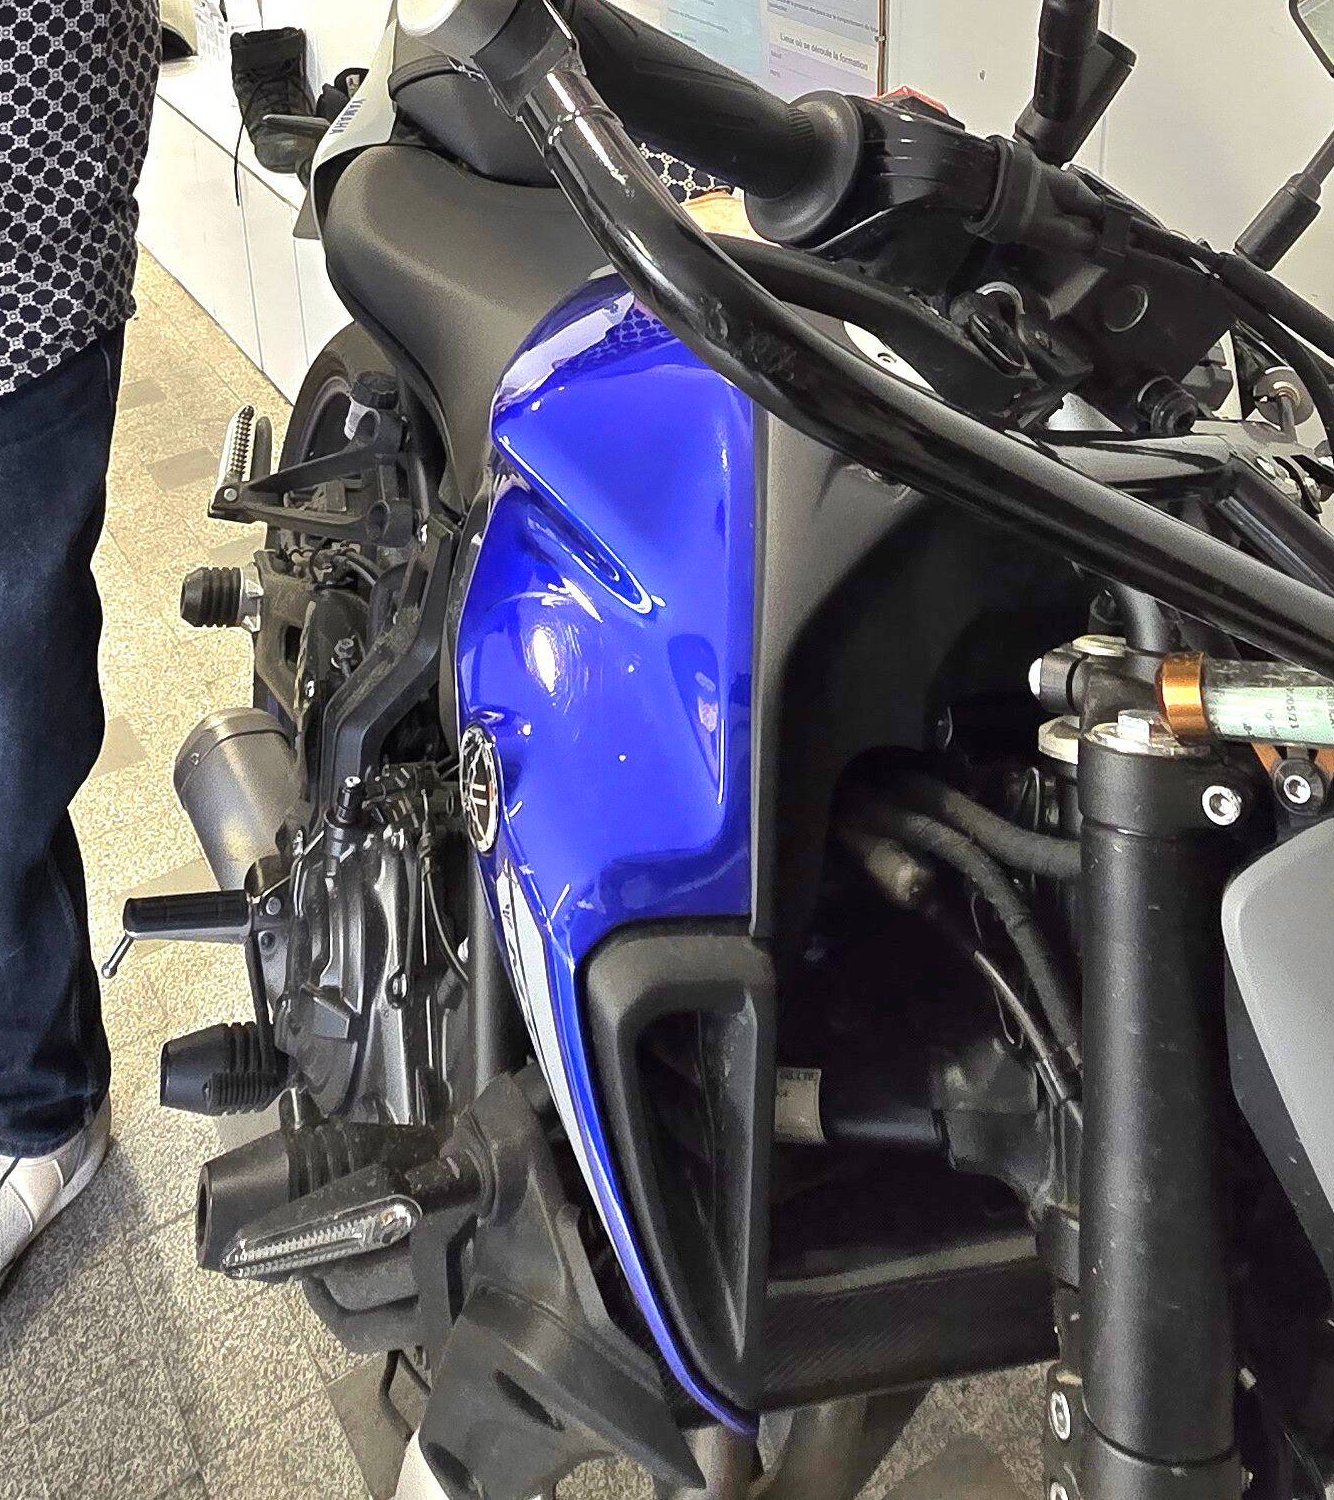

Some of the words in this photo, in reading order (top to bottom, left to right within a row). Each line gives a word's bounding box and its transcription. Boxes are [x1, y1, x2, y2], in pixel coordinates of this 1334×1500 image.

[780, 32, 794, 45] Lieux
[795, 37, 802, 48] où
[803, 41, 810, 50] se
[811, 42, 832, 58] déroule
[833, 50, 838, 60] la
[839, 52, 869, 71] formation
[329, 98, 366, 135] YAMAHA
